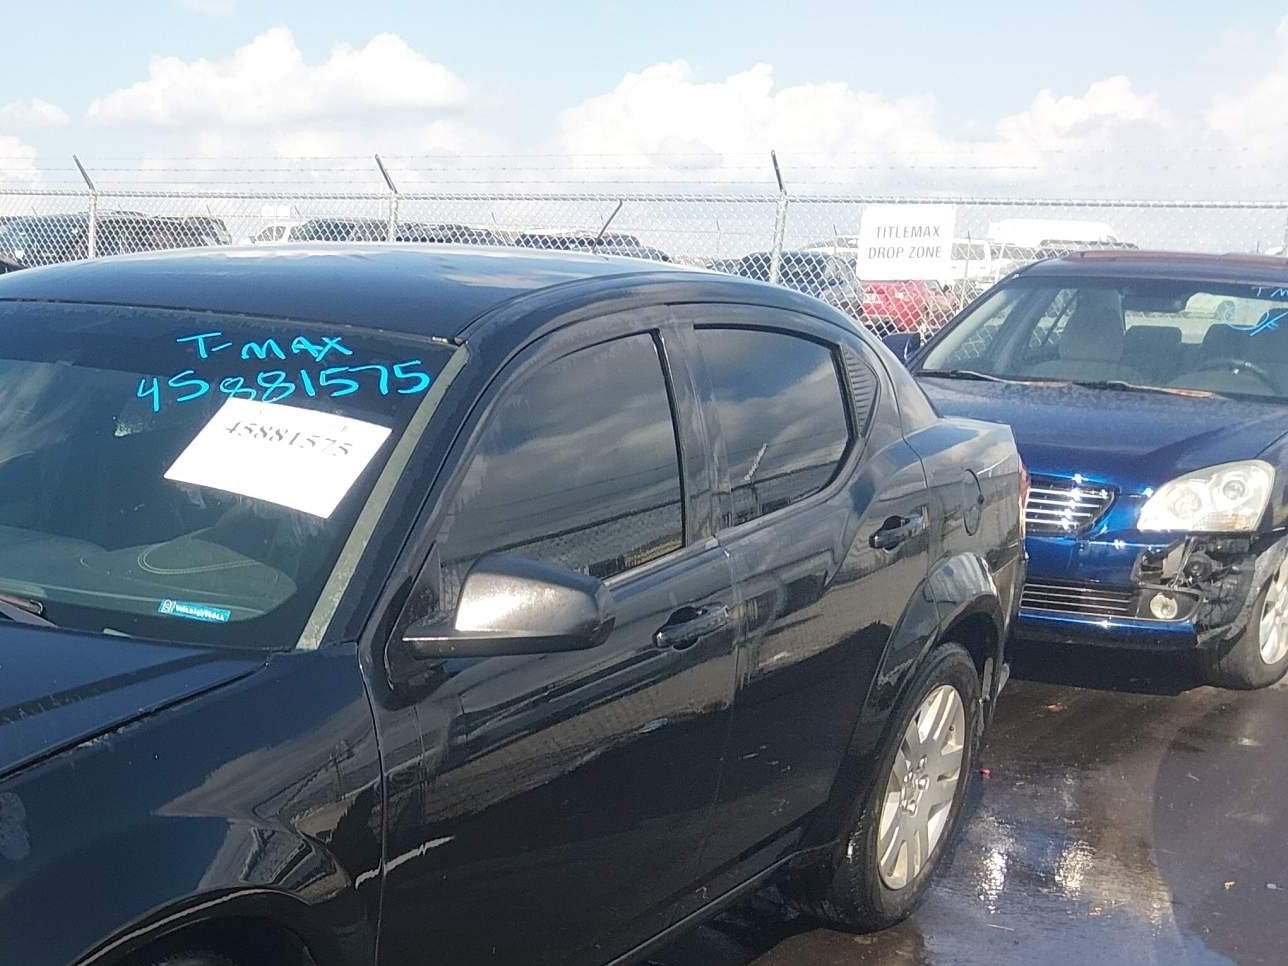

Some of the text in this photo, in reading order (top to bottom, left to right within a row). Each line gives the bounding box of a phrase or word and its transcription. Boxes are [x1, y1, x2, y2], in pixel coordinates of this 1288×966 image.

[876, 225, 941, 238] TITLEMAX
[868, 246, 943, 259] DROP ZONE
[176, 332, 352, 362] T-MAX
[137, 360, 430, 412] 45881575
[224, 420, 353, 457] 45881575
